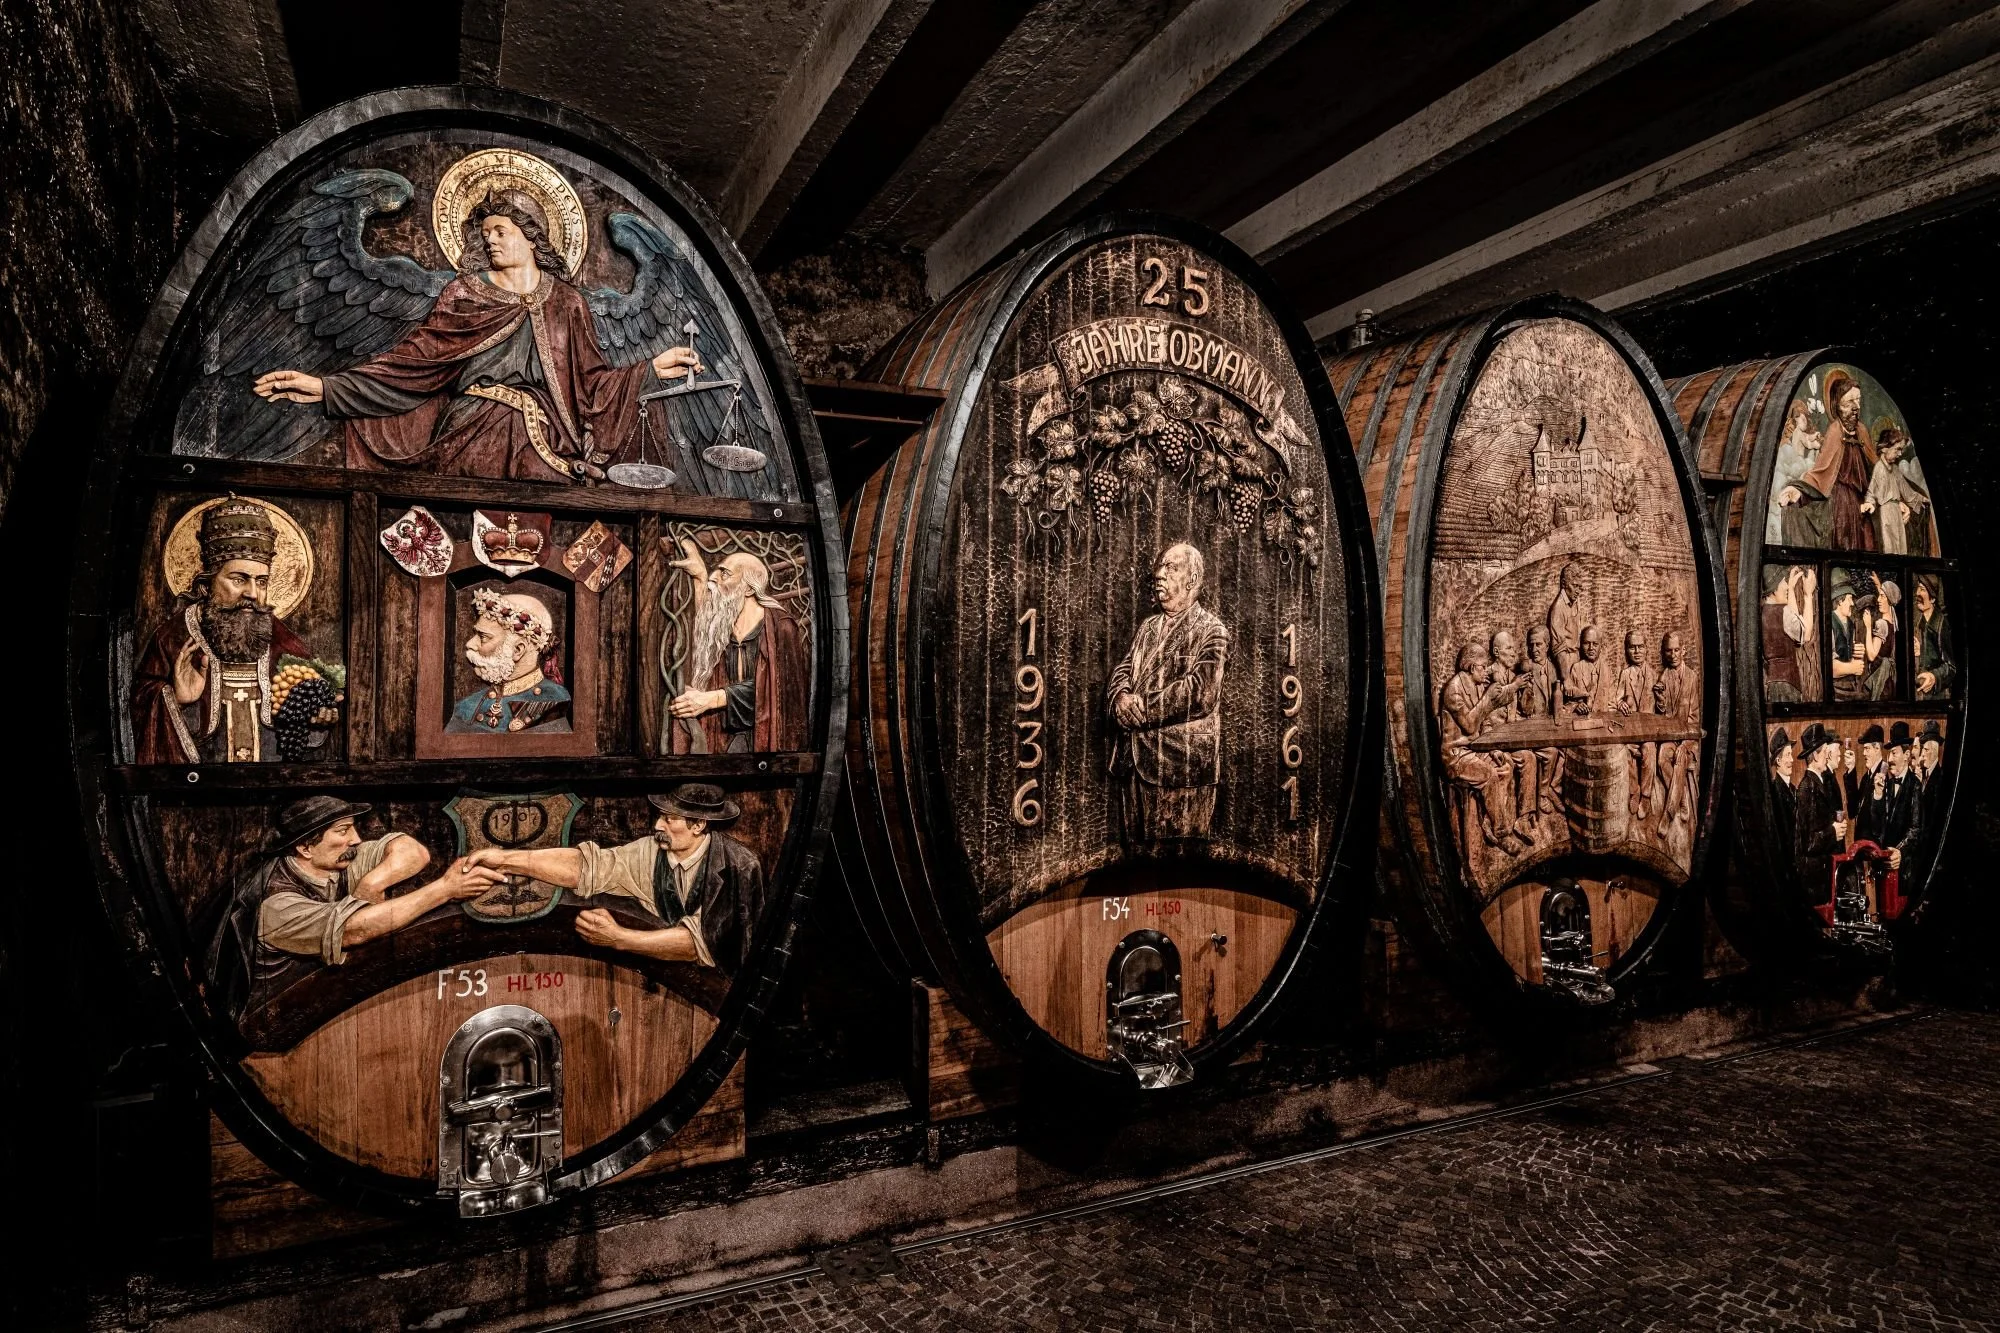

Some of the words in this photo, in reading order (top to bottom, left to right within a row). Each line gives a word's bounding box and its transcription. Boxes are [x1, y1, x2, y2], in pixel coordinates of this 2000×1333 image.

[1142, 257, 1209, 316] 25
[1071, 324, 1163, 375] JAHRE
[1169, 329, 1276, 405] OBMANN
[1013, 608, 1044, 827] 1936
[1281, 623, 1303, 821] 1961
